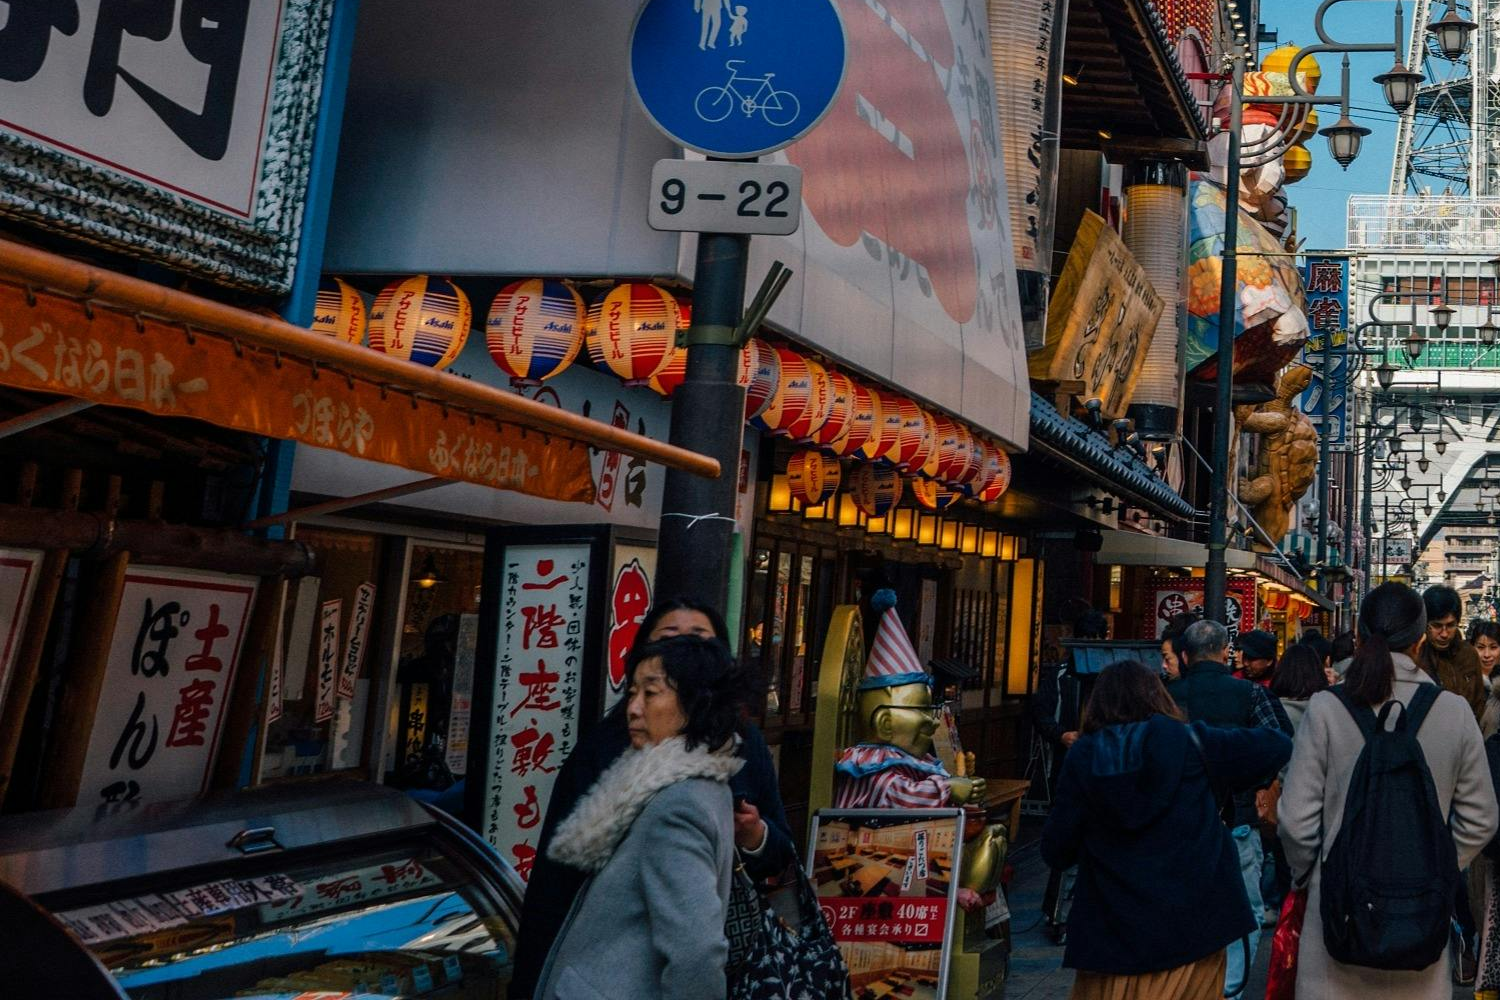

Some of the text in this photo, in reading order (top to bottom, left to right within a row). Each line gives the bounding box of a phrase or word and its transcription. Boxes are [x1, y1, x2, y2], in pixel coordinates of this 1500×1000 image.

[388, 290, 417, 350] アサヒビール
[424, 316, 455, 332] Asahi
[1307, 258, 1343, 330] 麻雀
[509, 294, 530, 355] アサヒビール
[542, 321, 573, 335] Asahi
[609, 300, 625, 360] アサヒビール
[636, 320, 666, 333] Asahi
[166, 603, 230, 749] 土産
[839, 905, 859, 921] 2F
